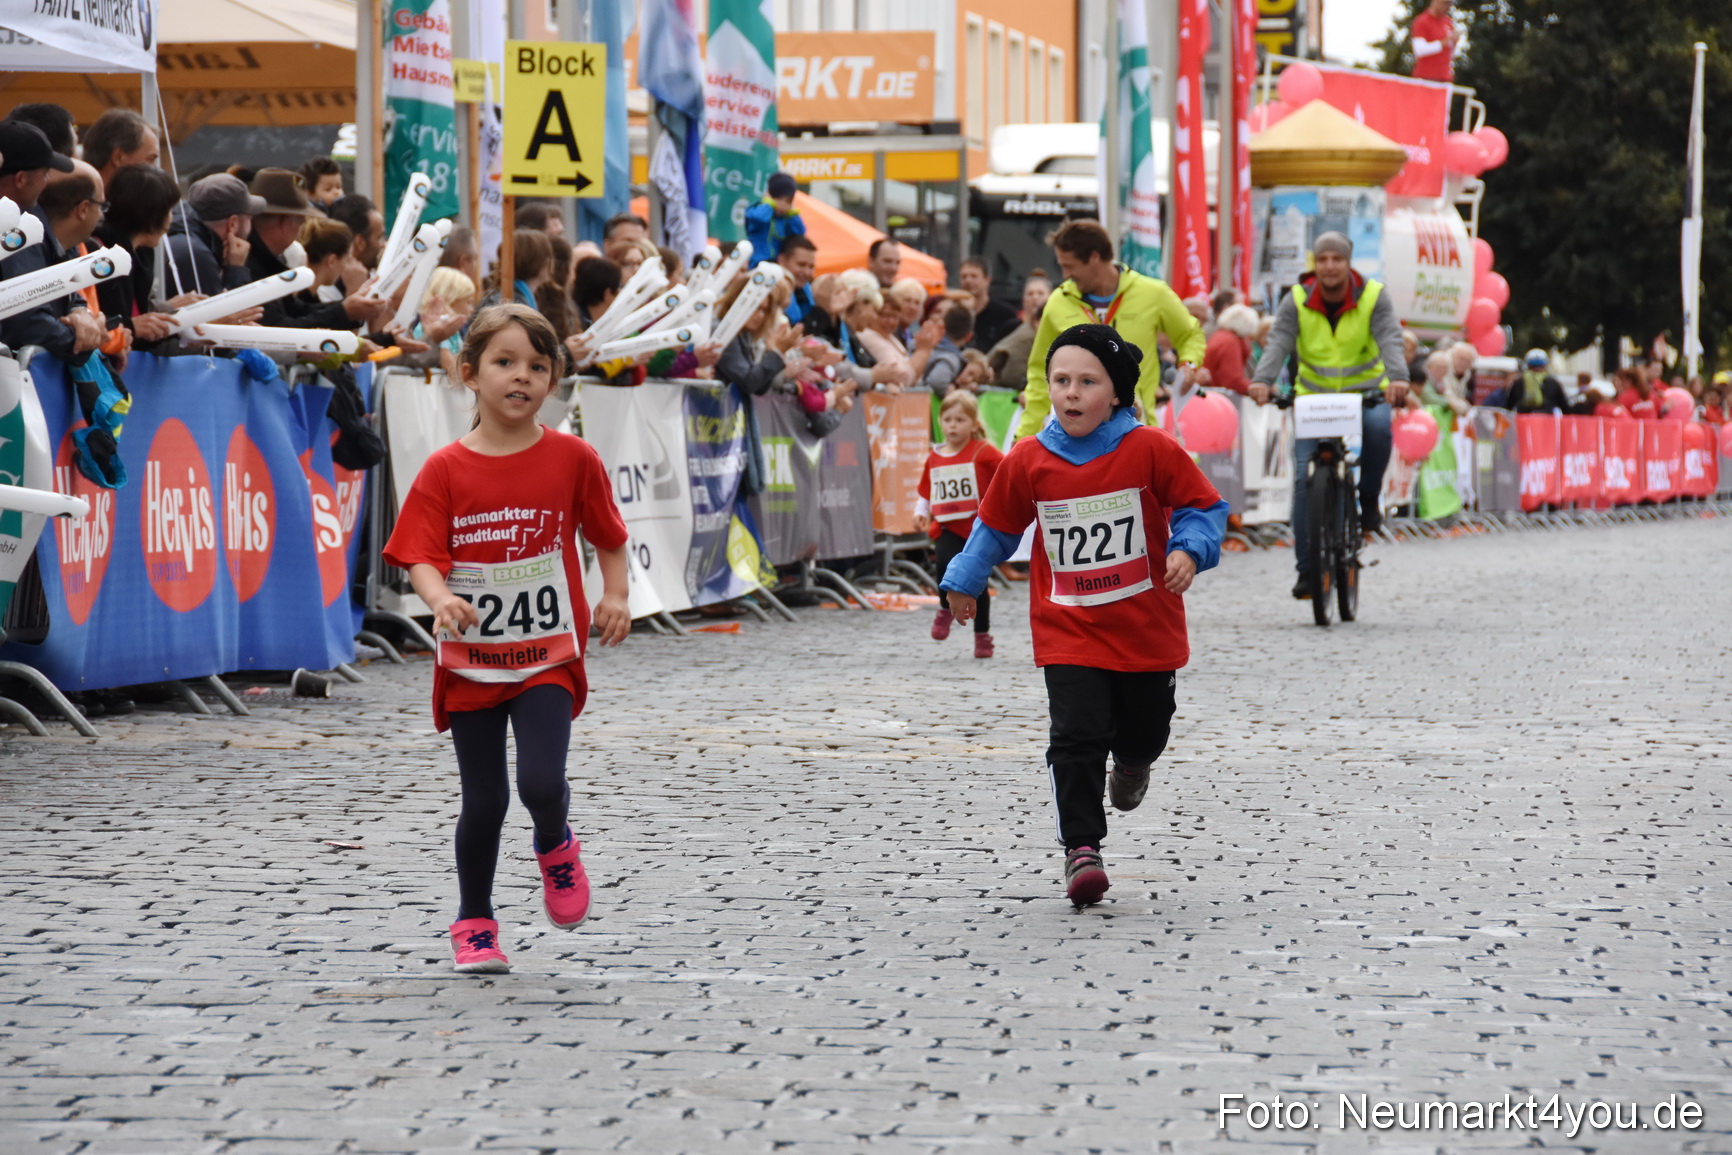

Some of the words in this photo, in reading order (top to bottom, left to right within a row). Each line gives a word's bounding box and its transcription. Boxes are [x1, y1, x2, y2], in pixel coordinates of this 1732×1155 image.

[517, 47, 595, 76] Block
[524, 88, 582, 163] A
[933, 477, 973, 501] 7036
[147, 460, 216, 573] Hervis
[1075, 493, 1132, 516] BOCK
[452, 507, 537, 529] Neumarkter
[452, 524, 519, 548] Stadtlauf
[1049, 515, 1135, 566] 7227
[493, 558, 553, 583] BOCK
[1075, 573, 1121, 592] Hanna
[468, 646, 549, 666] Henriette
